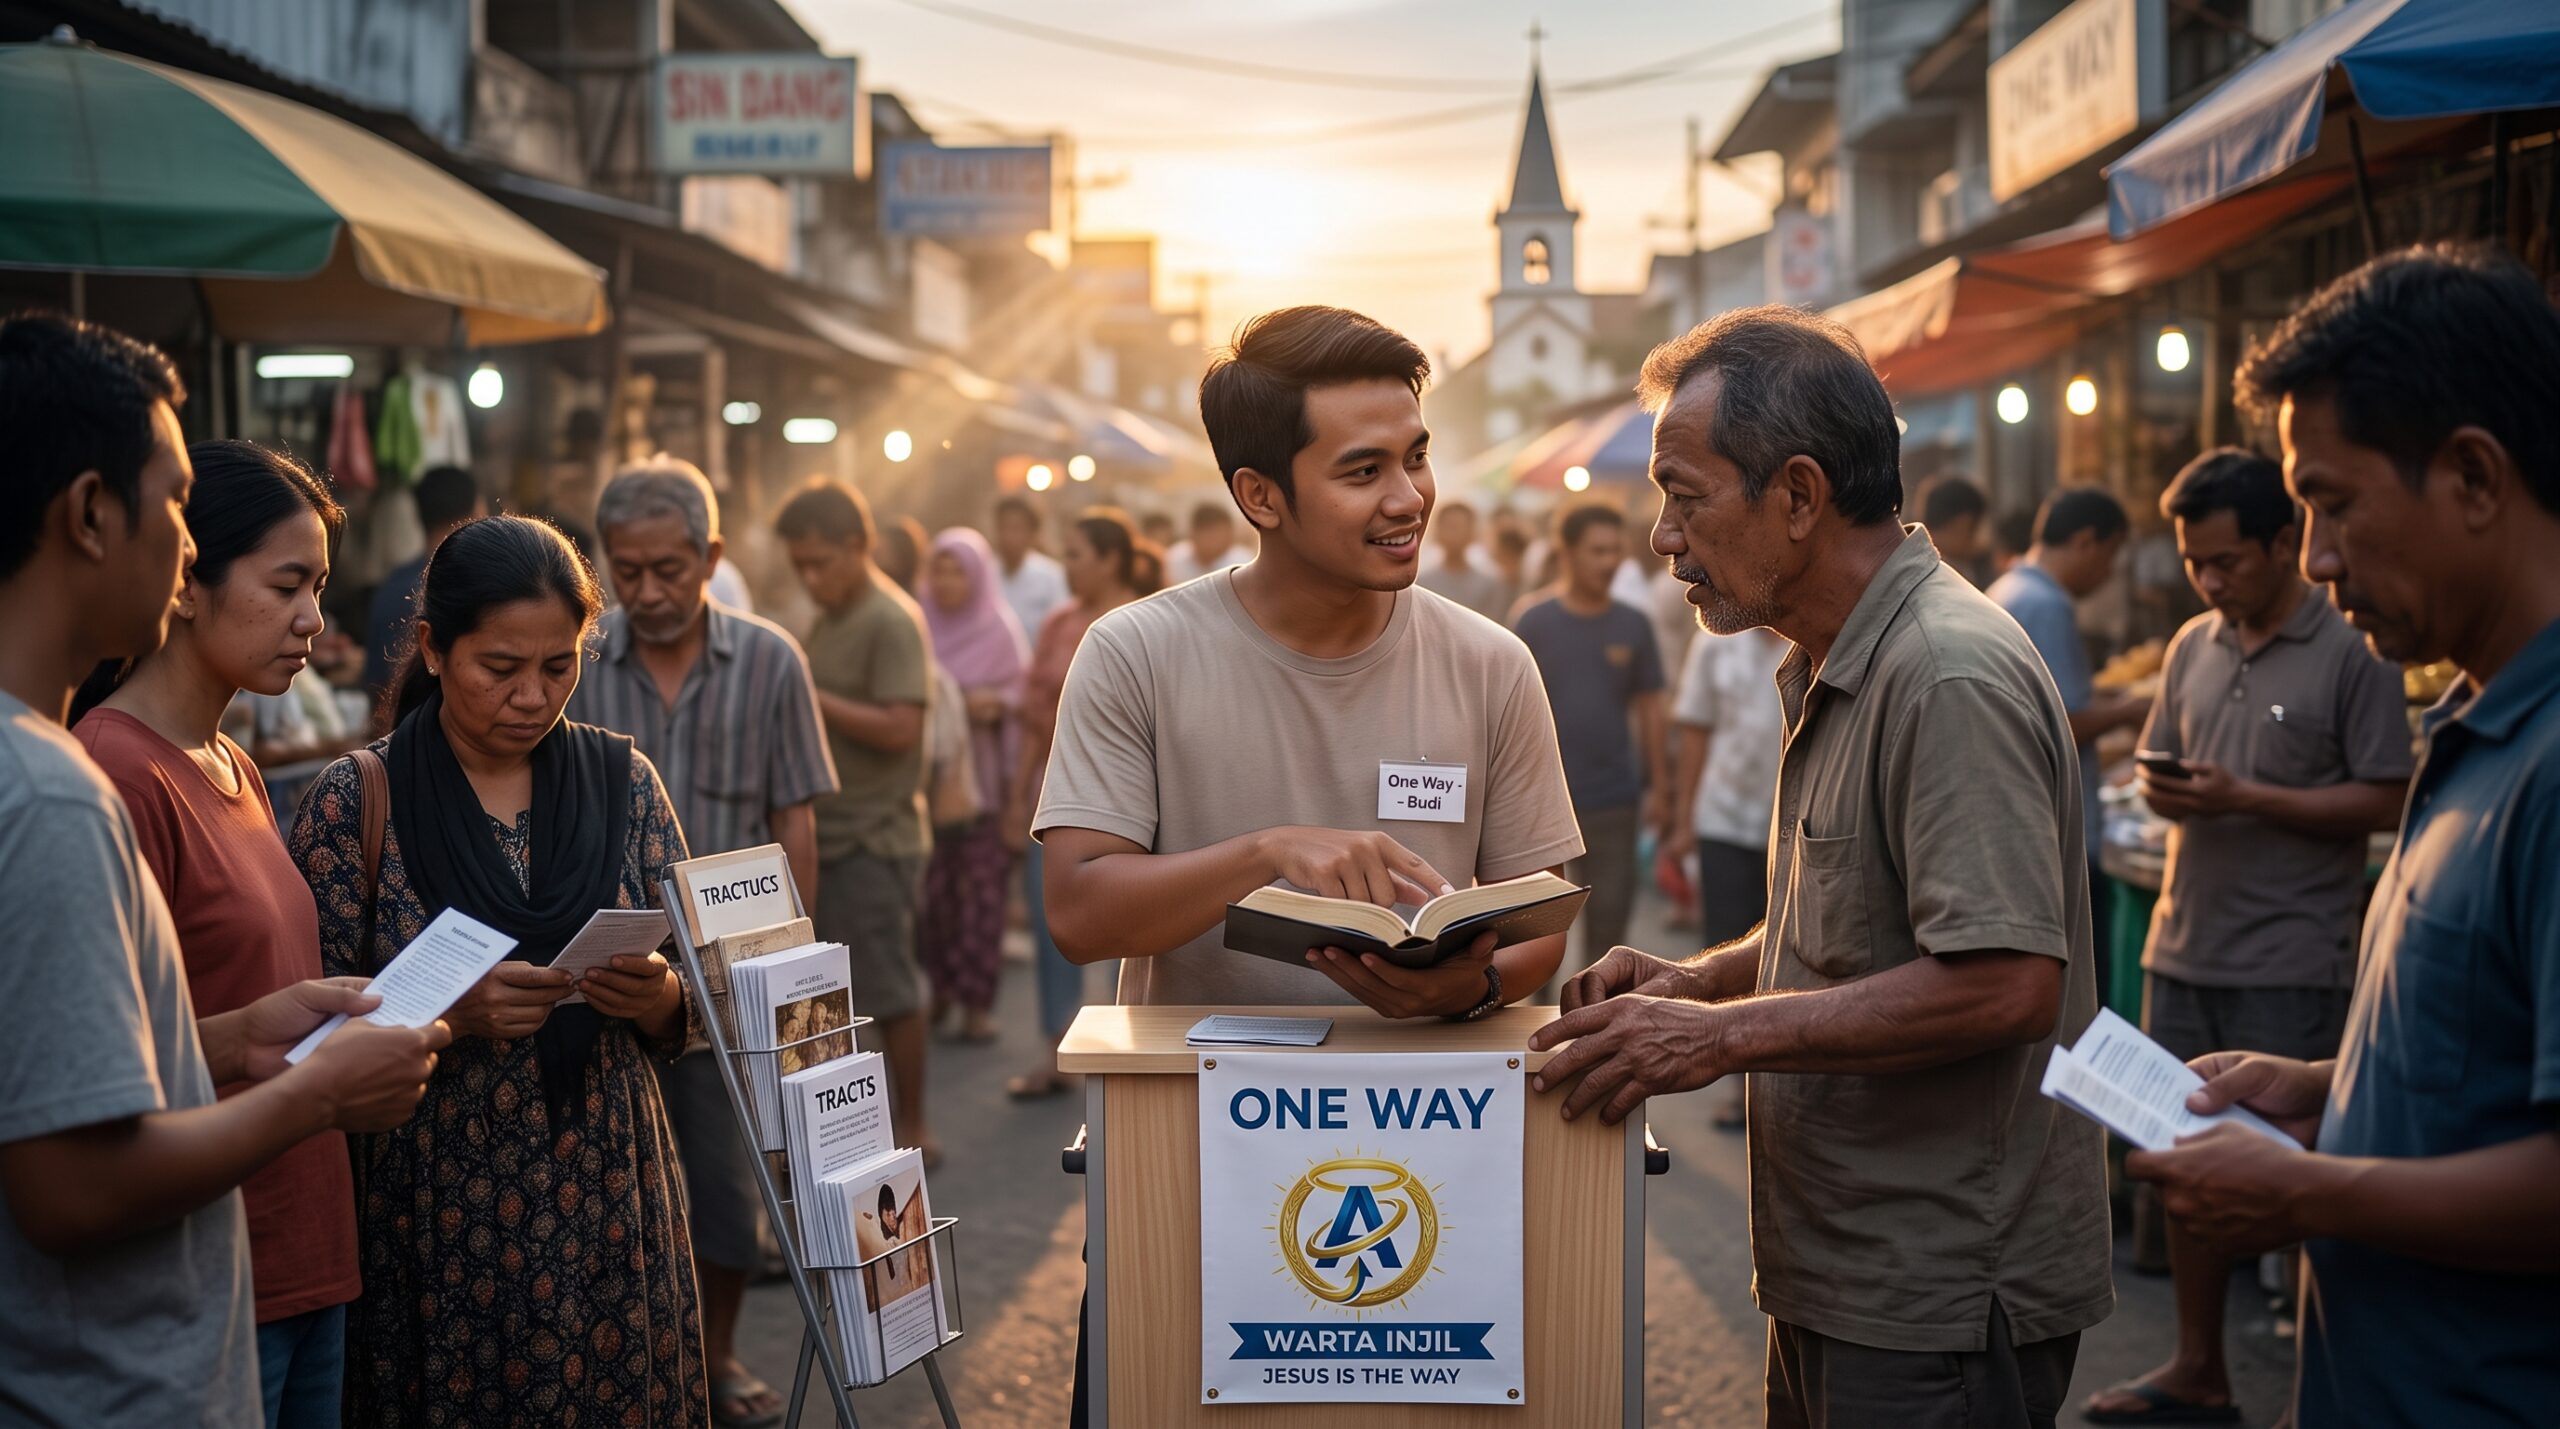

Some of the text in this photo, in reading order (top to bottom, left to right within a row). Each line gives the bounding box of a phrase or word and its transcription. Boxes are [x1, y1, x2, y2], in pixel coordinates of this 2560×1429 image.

[1388, 774, 1418, 788] One
[1422, 776, 1454, 793] Way
[1407, 796, 1441, 810] Budi
[700, 875, 779, 906] TRACTUCS
[815, 1075, 876, 1114] TRACTS
[1230, 1088, 1495, 1130] ONE WAY
[1263, 1330, 1461, 1353] WARTA INJIL
[1263, 1368, 1461, 1384] JESUS IS THE WAY
